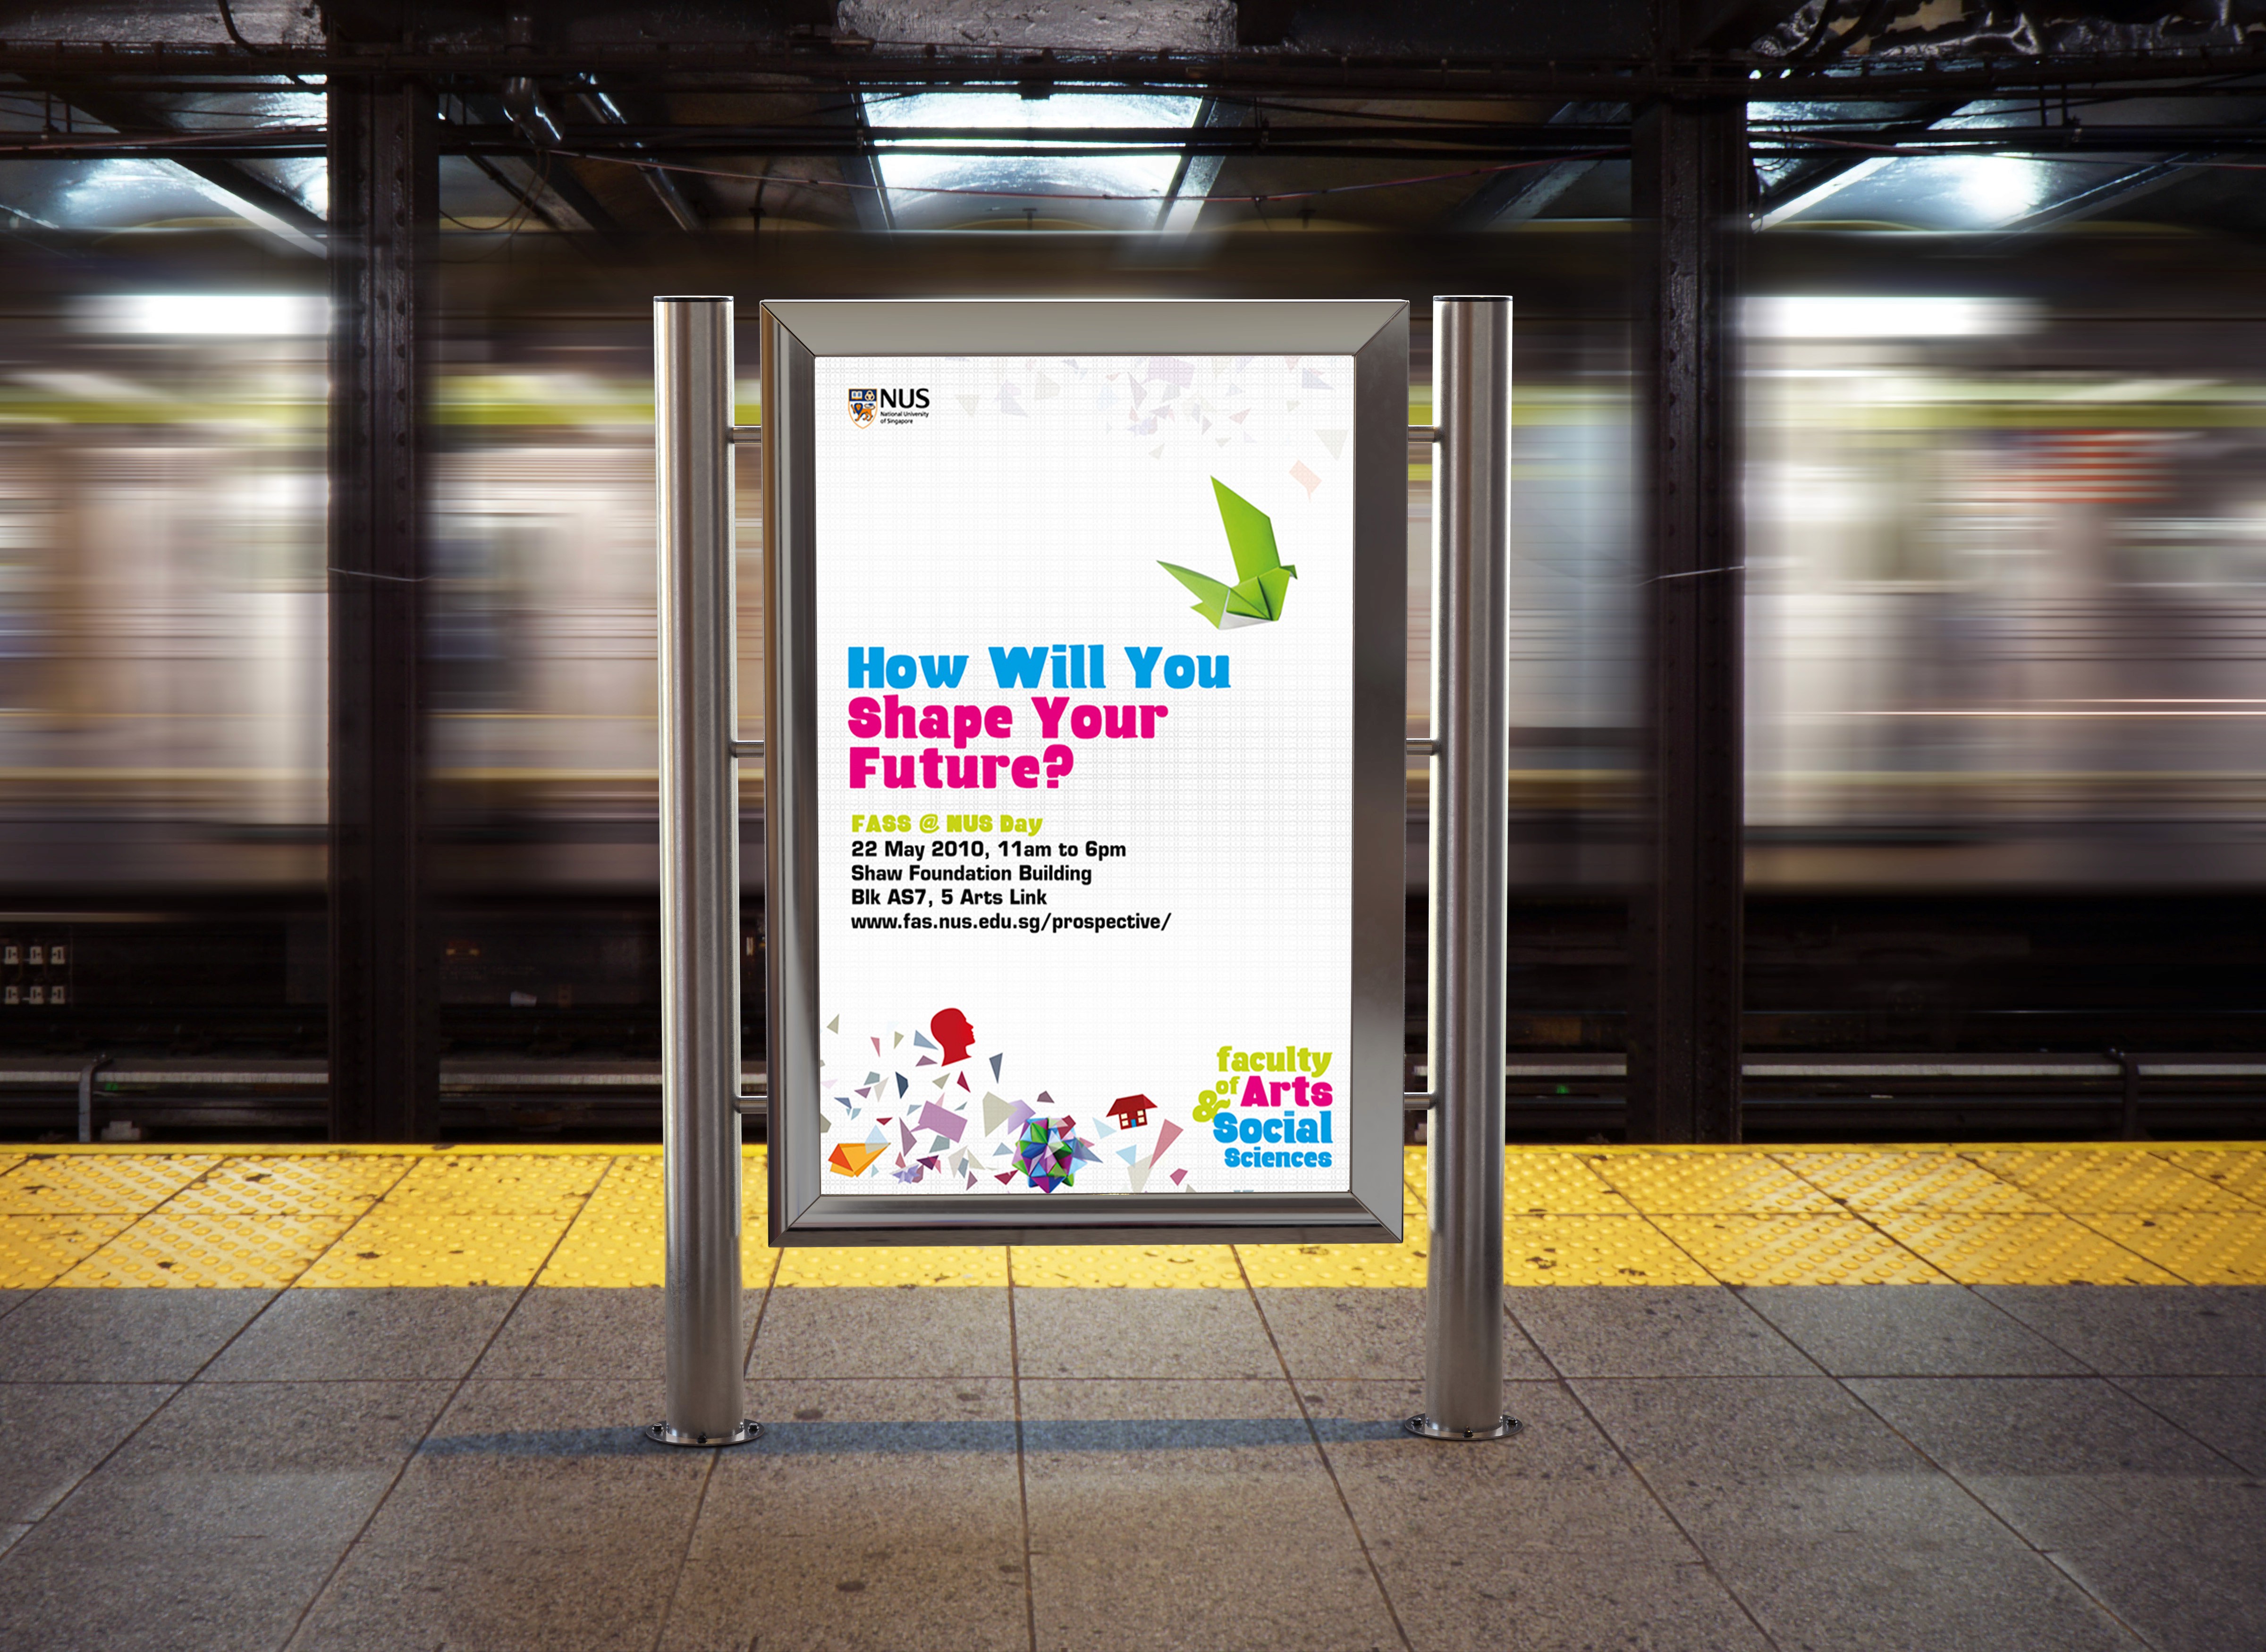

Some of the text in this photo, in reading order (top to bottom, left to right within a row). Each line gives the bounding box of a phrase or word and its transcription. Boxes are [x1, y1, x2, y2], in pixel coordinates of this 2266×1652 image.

[880, 388, 930, 409] NUS
[848, 644, 1231, 690] How Will You
[847, 694, 1169, 749] Shape Your
[849, 743, 1074, 789] Future?
[852, 813, 1043, 837] FASS @ NUS Day
[852, 840, 1126, 861] 22 May 2010, 11am to 6pm
[851, 864, 1092, 885] Shaw Foundation Building
[852, 888, 1048, 908] Blk AS7, 5 Arts Link
[851, 912, 1172, 934] www.fas.nus.edu.sg/prospective/
[1216, 1045, 1333, 1078] faculty
[1215, 1075, 1333, 1107] of Arts
[1192, 1089, 1333, 1144] & Social
[1224, 1146, 1332, 1168] Sciences
